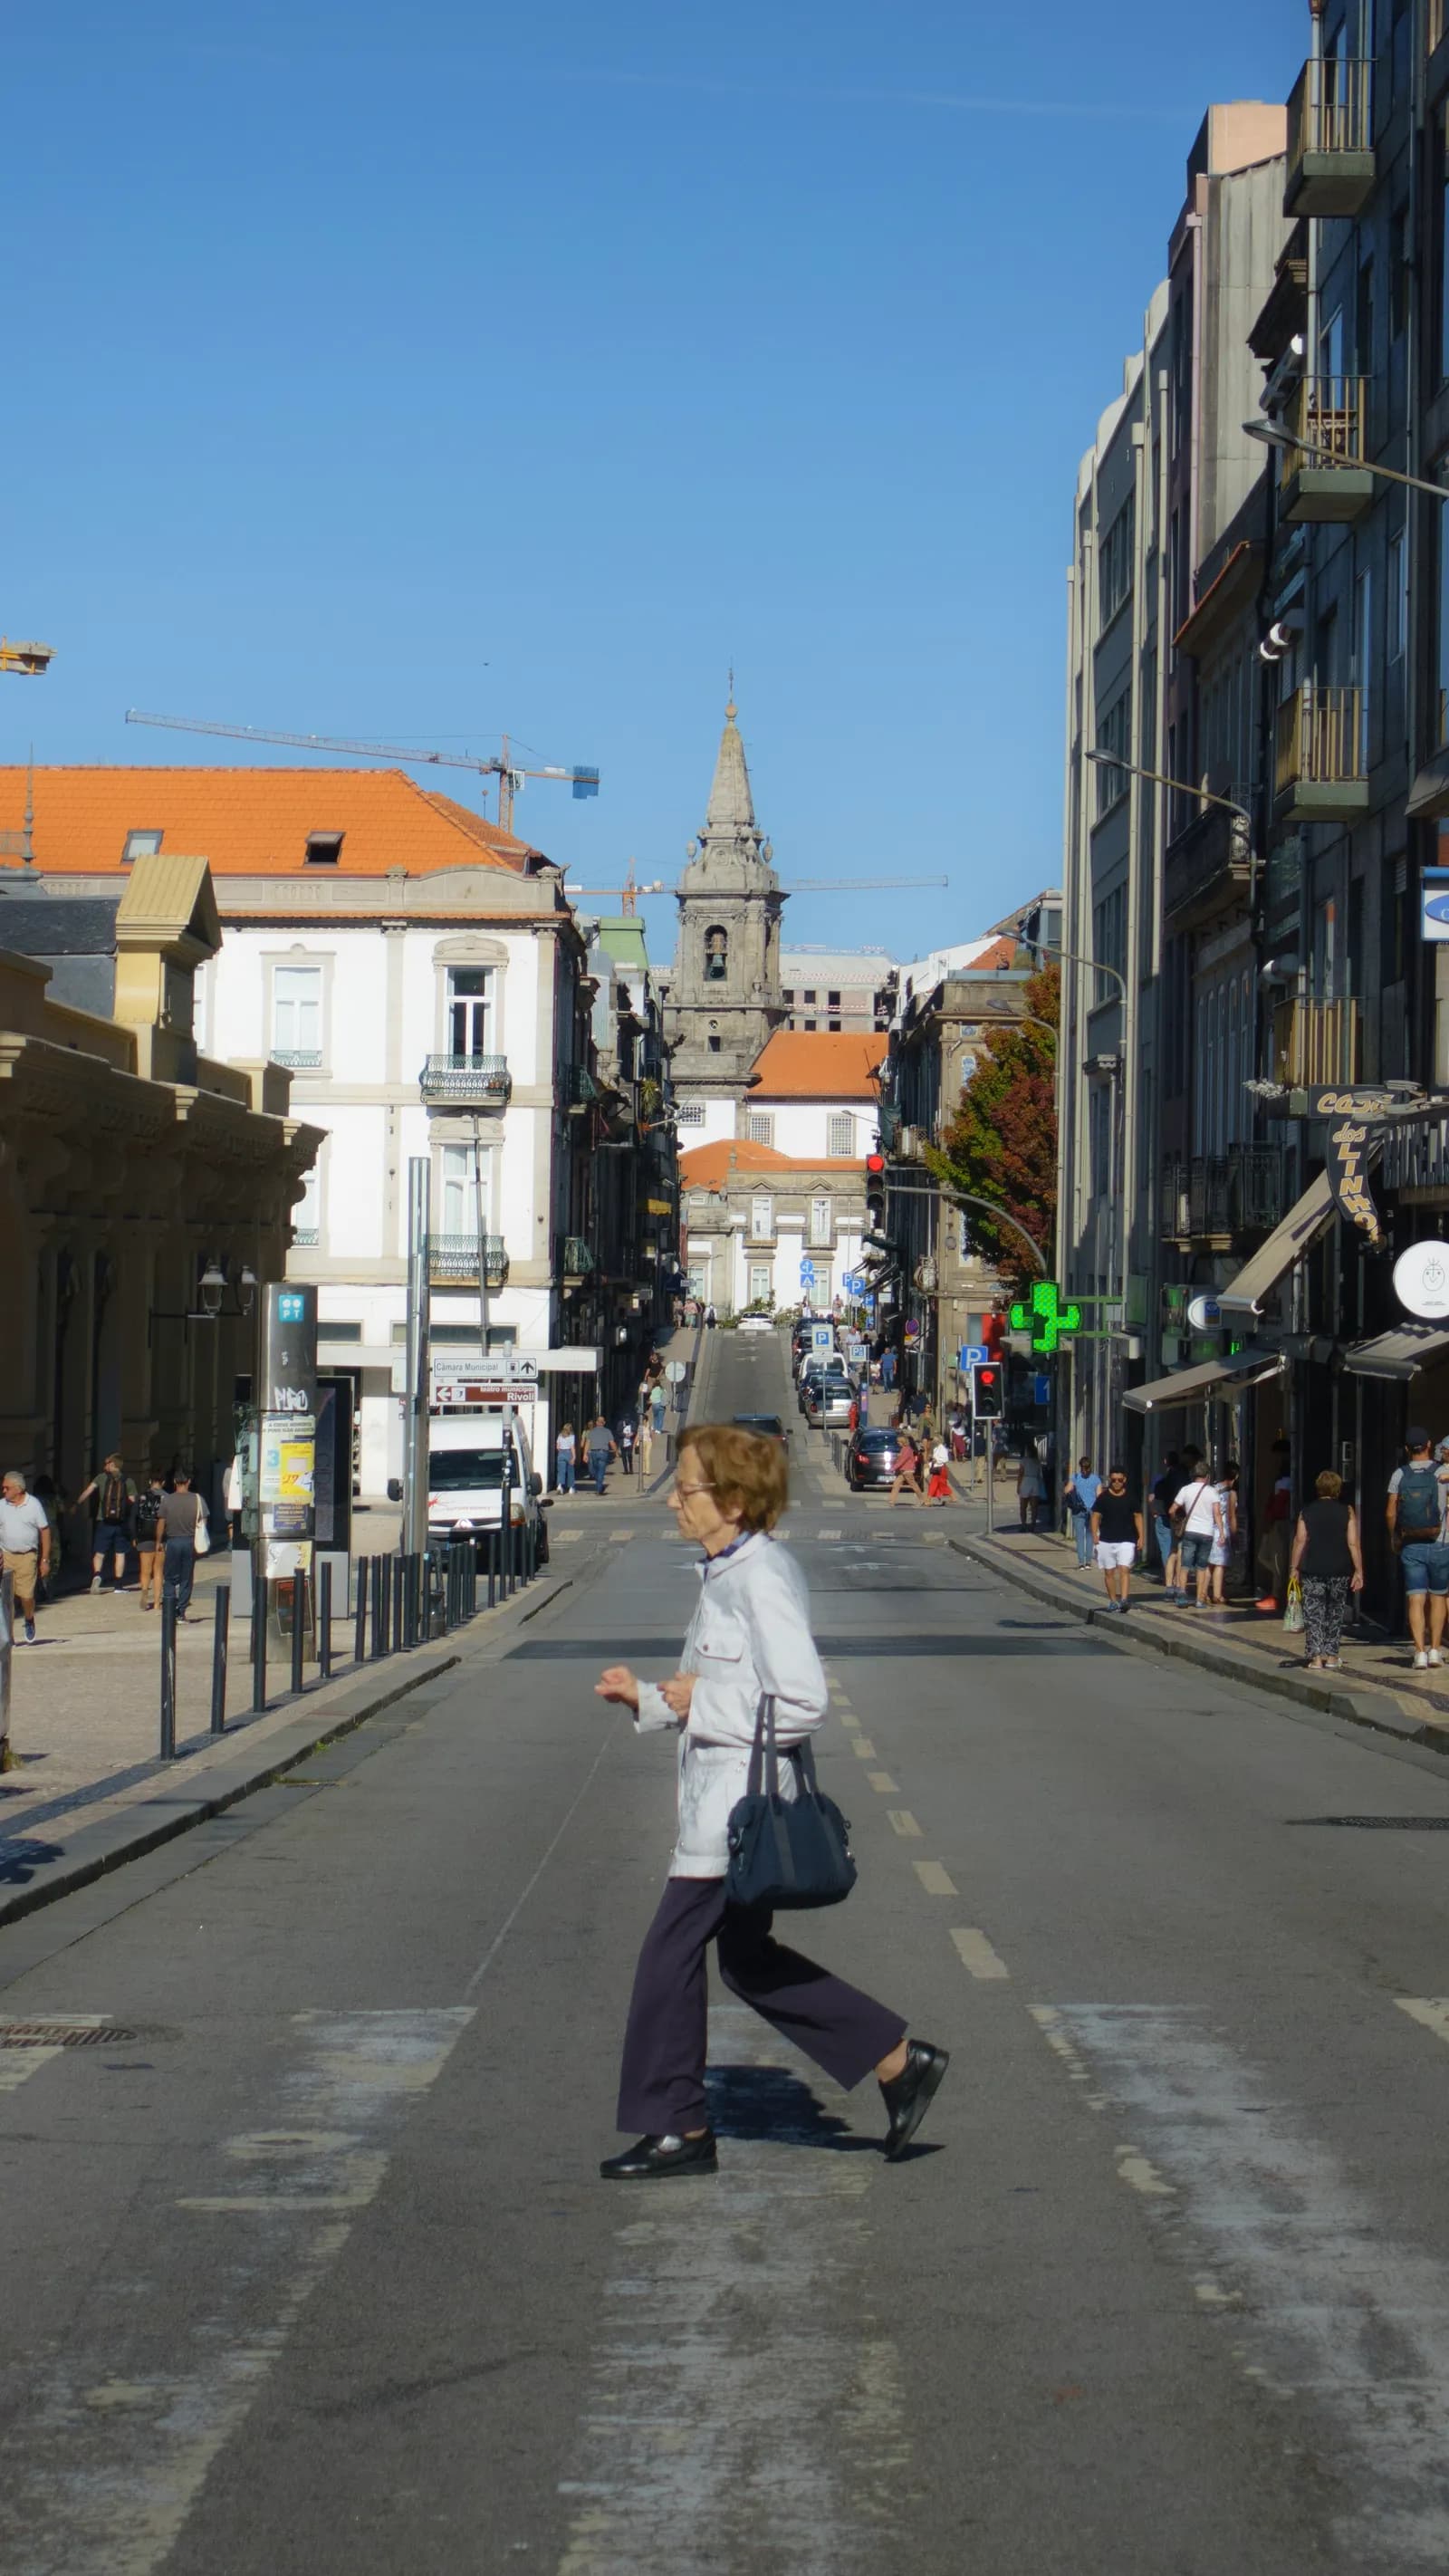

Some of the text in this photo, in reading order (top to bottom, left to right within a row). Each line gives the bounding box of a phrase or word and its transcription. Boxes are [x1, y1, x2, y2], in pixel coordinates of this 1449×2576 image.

[1332, 1121, 1367, 1143] dos
[852, 1281, 861, 1292] P
[818, 1332, 827, 1344] P
[965, 1348, 983, 1370] P
[437, 1362, 499, 1372] Câmara Municipal
[507, 1392, 535, 1400] Rivoli
